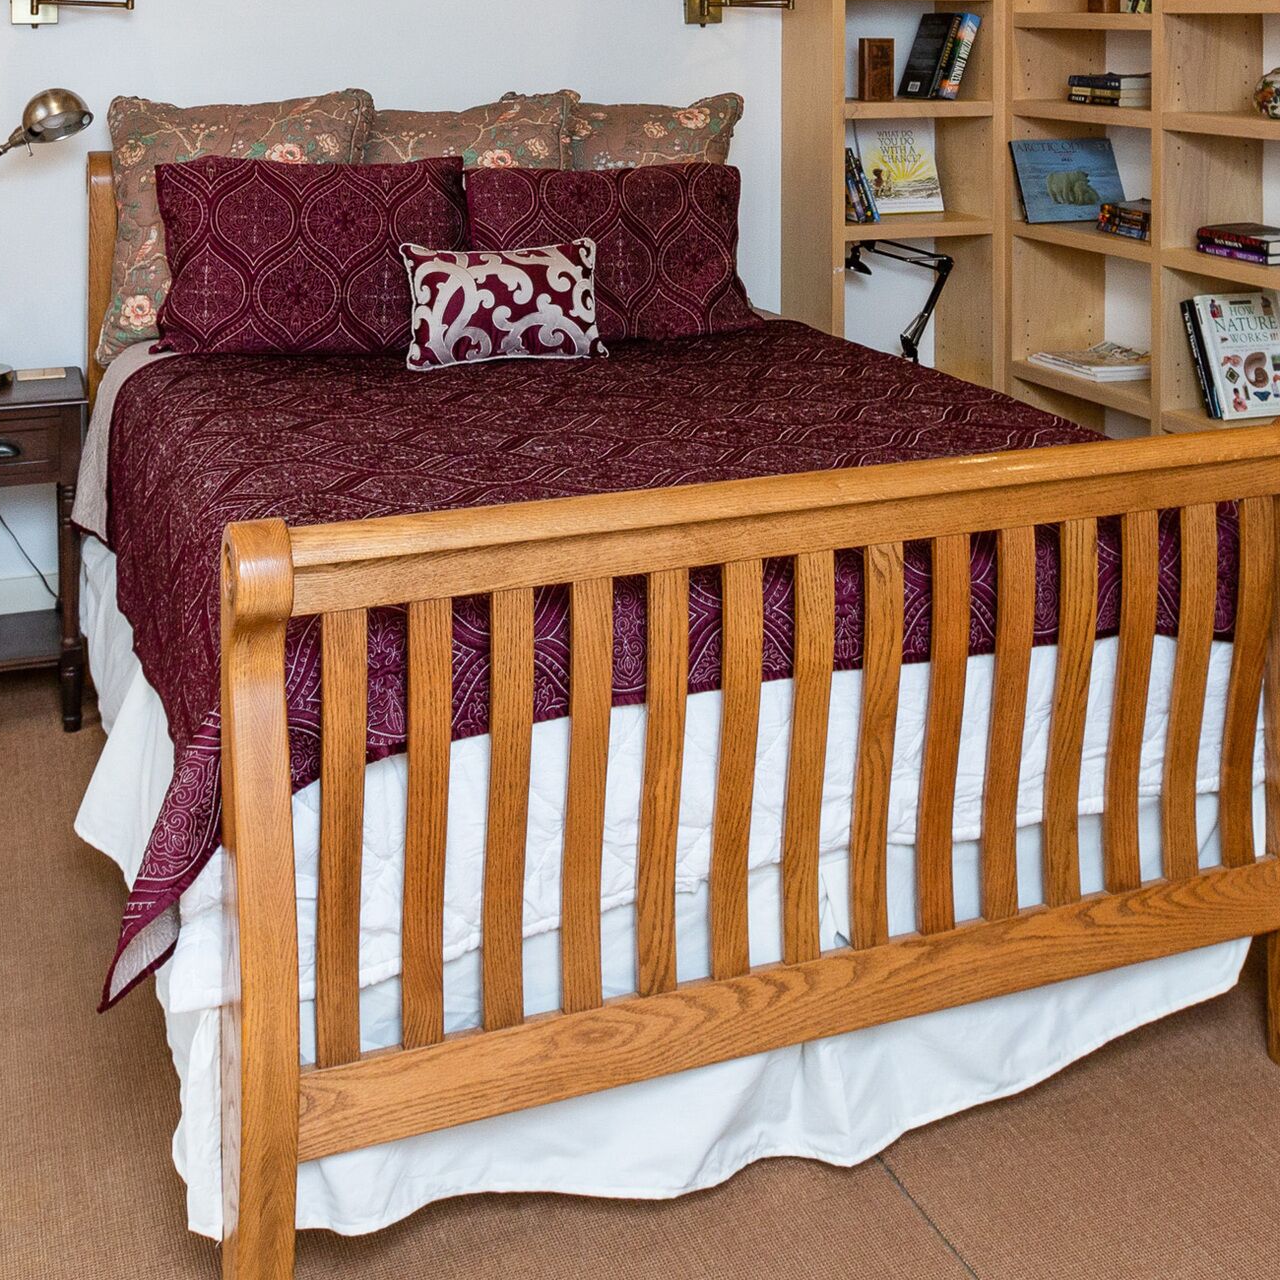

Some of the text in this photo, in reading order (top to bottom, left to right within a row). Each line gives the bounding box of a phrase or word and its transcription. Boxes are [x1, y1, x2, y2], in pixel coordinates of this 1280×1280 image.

[877, 137, 914, 146] YOU DO
[880, 146, 907, 154] WITH
[1015, 143, 1058, 152] ARCTIC
[1229, 305, 1255, 316] HOW
[1215, 316, 1278, 332] NATURE
[1230, 332, 1269, 343] WORKS
